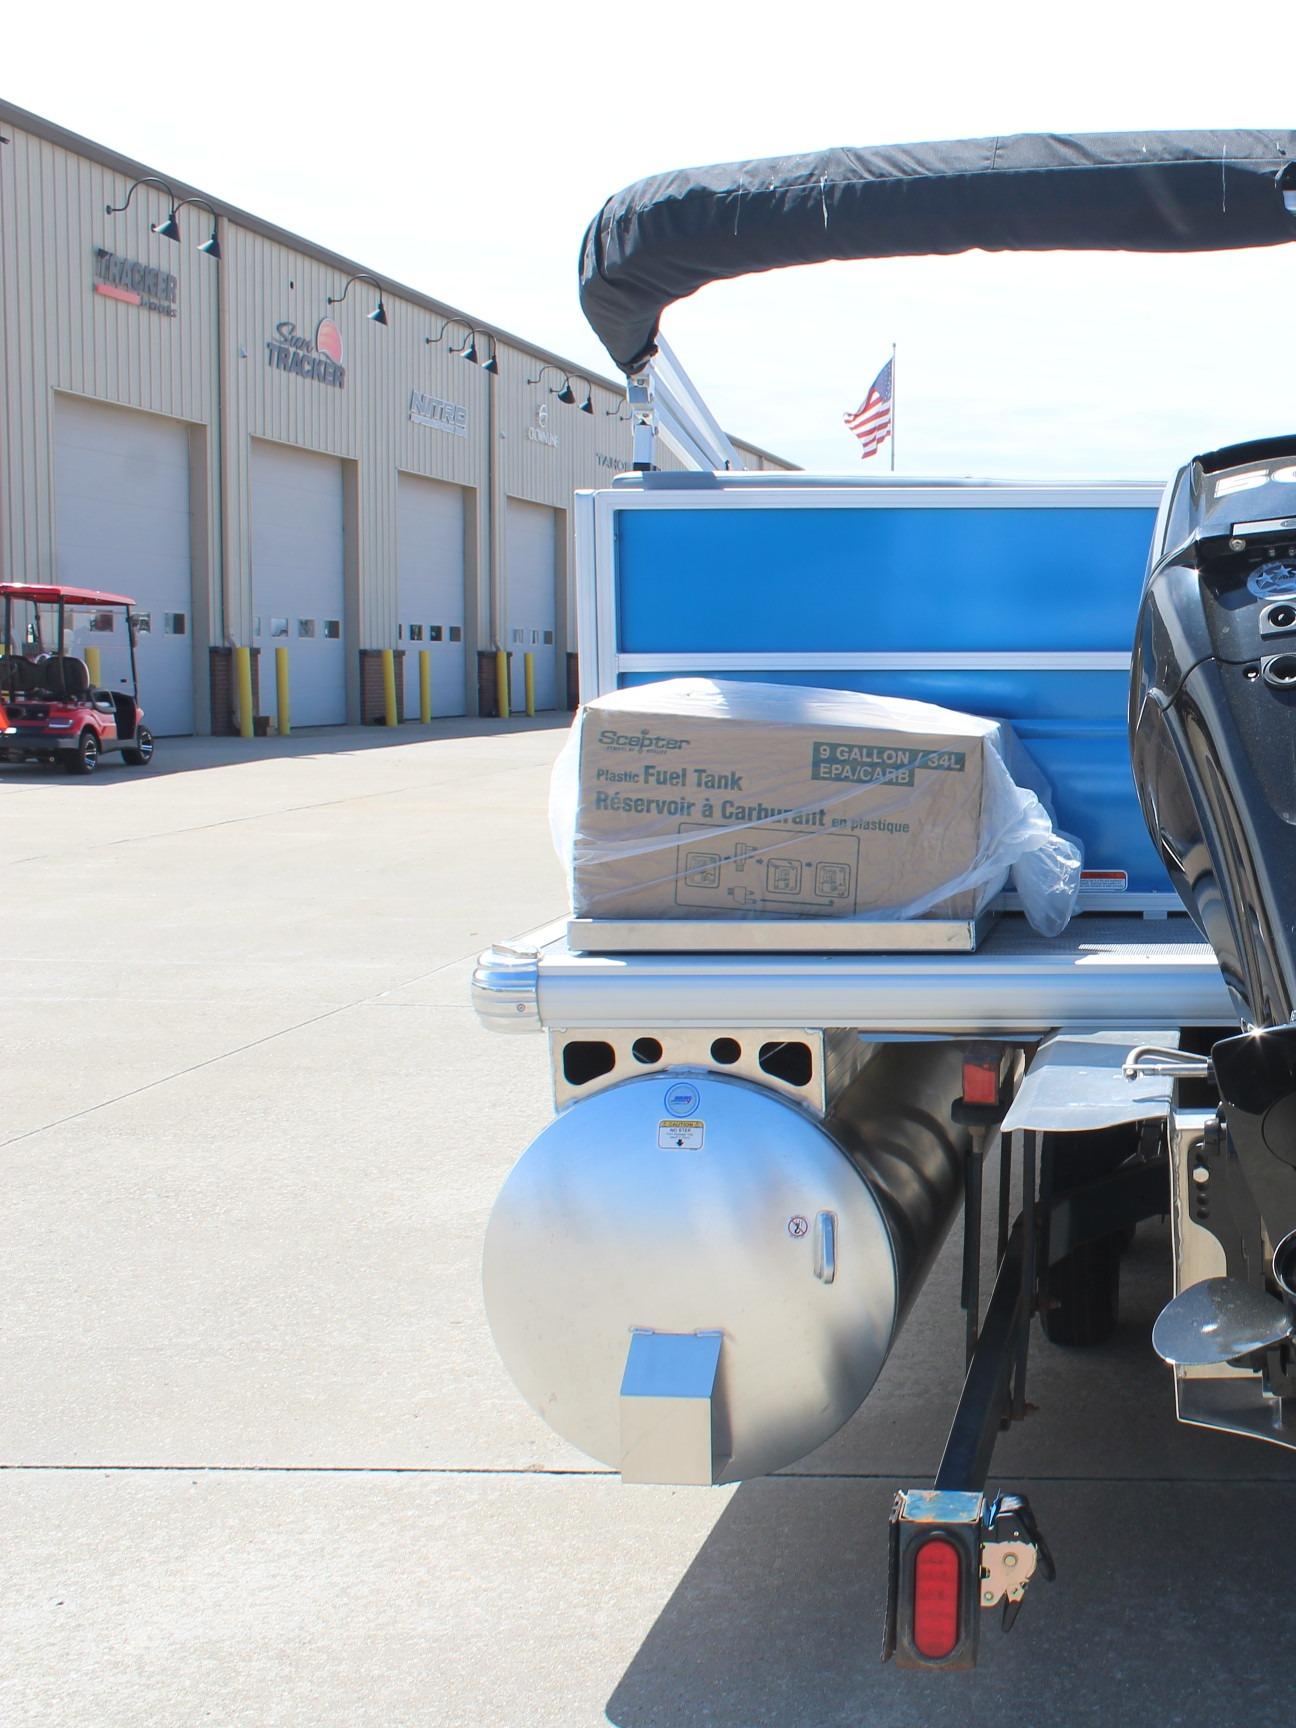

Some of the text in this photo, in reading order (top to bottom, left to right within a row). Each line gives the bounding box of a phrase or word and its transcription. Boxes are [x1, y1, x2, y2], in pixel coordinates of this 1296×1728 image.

[94, 247, 177, 304] TRACKER
[271, 321, 313, 354] Sun
[267, 342, 346, 389] TRACKER
[598, 729, 691, 753] Scepter
[819, 745, 830, 759] 9
[836, 746, 910, 765] GALLON
[927, 753, 961, 769] 34L
[596, 764, 743, 791] Plastic Fuel Tank
[819, 763, 910, 784] EPA/CARB
[595, 790, 696, 817] Réservoir
[701, 798, 714, 818] à
[831, 817, 848, 829] en
[850, 817, 910, 834] plastique
